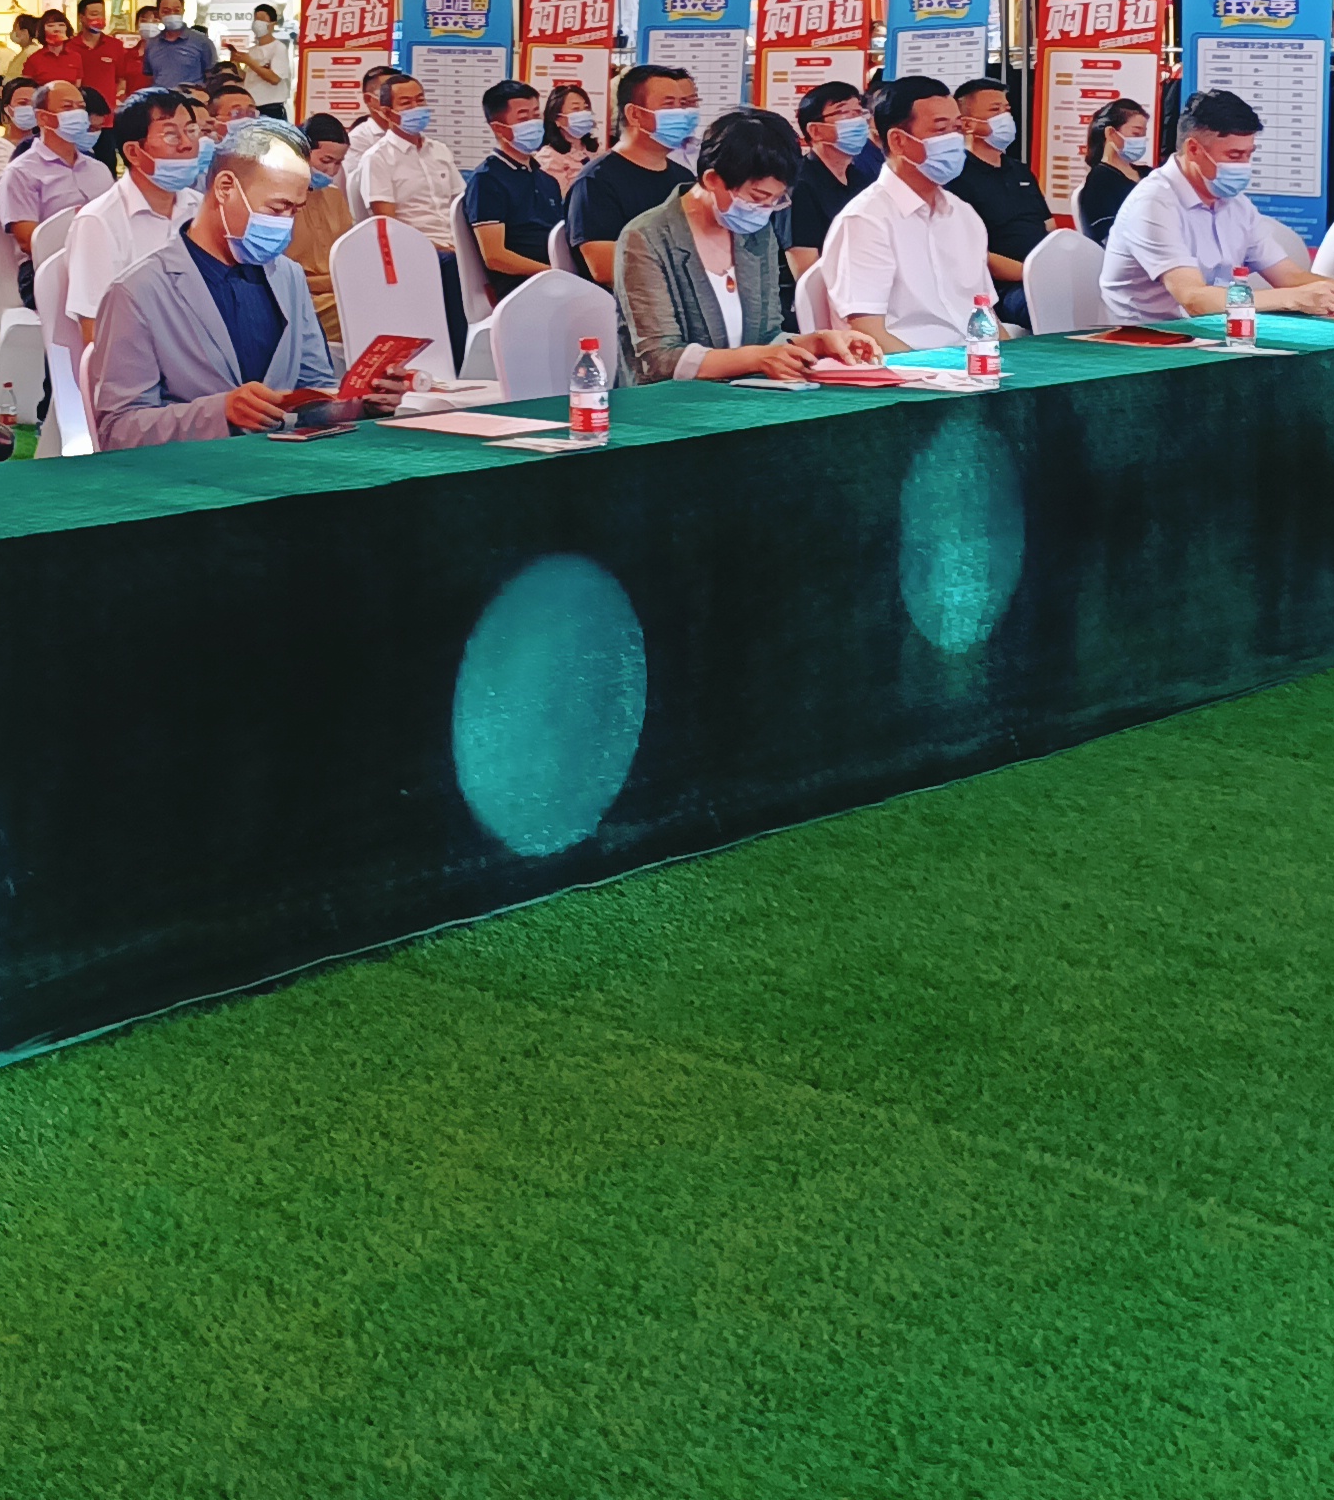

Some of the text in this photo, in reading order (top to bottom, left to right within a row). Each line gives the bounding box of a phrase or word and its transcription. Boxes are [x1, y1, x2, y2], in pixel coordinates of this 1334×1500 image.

[235, 12, 254, 21] MO
[1215, 0, 1298, 17] 狂欢季
[426, 14, 487, 29] 狂欢季
[761, 0, 864, 42] 购周边
